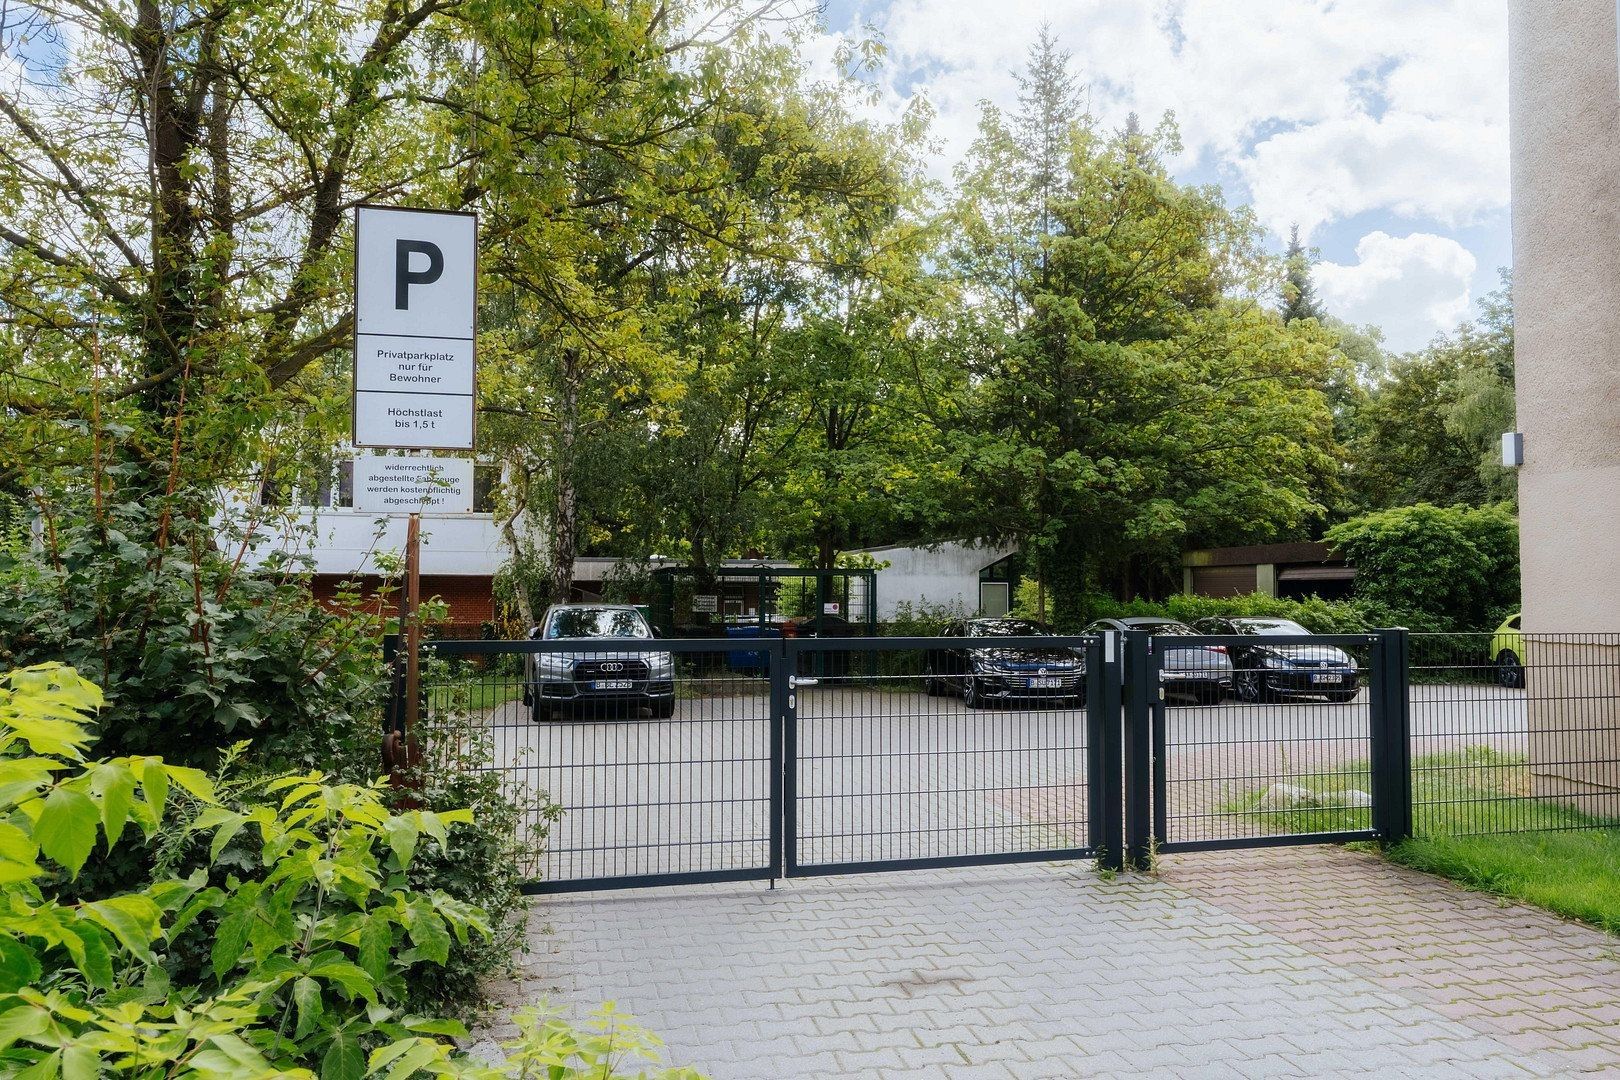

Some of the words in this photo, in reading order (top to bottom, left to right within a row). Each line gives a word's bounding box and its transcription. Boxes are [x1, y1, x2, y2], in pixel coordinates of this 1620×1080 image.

[395, 238, 444, 310] P
[377, 349, 454, 362] Privatparkplatz
[418, 363, 433, 371] für
[389, 373, 442, 383] Bewohner
[387, 407, 443, 418] Höchstlast
[395, 420, 410, 428] bis
[413, 420, 429, 429] 1,5
[431, 420, 436, 429] t
[384, 464, 445, 472] widerrechtlch
[368, 474, 415, 483] abgestellte
[400, 486, 461, 495] kostenpflichtig
